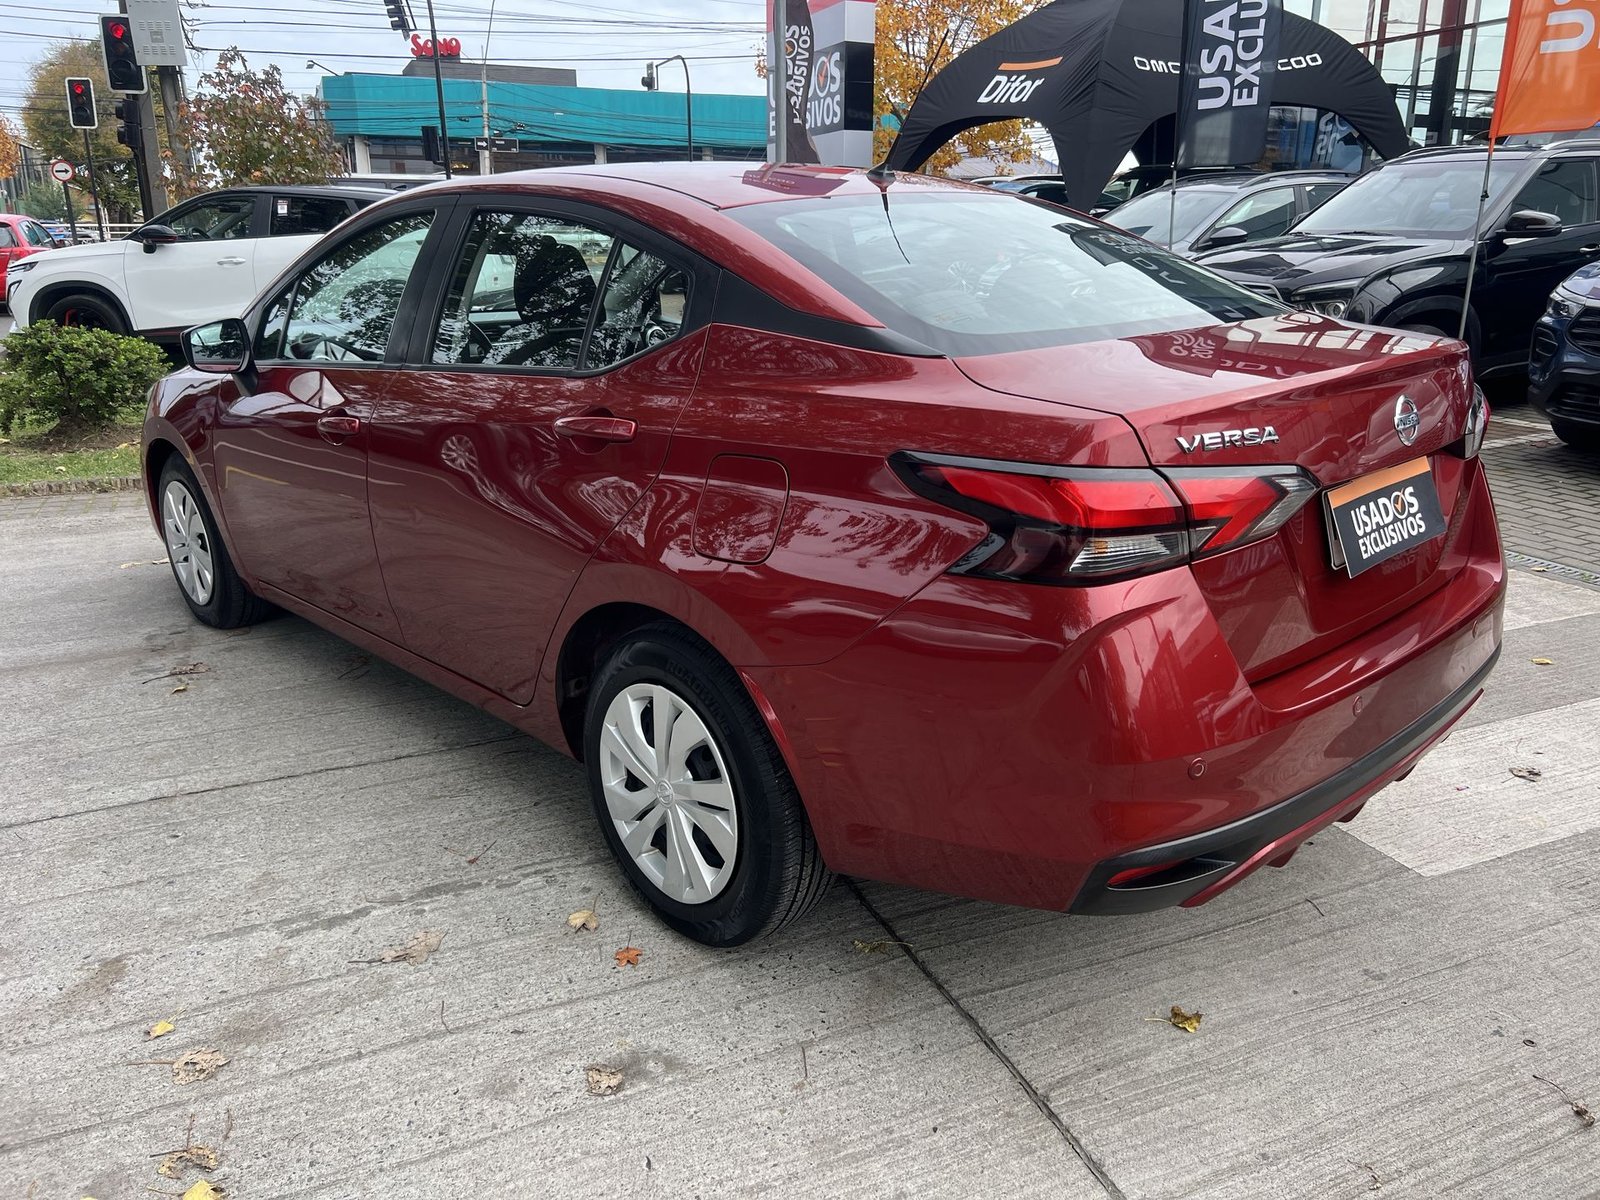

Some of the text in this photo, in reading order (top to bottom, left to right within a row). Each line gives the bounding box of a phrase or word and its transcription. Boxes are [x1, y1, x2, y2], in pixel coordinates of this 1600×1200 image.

[1198, 0, 1238, 110] USA
[976, 74, 1045, 104] Difor
[1175, 425, 1280, 455] VERSA
[1350, 486, 1419, 537] USADOS
[1358, 512, 1426, 560] EXCLUSIVOS
